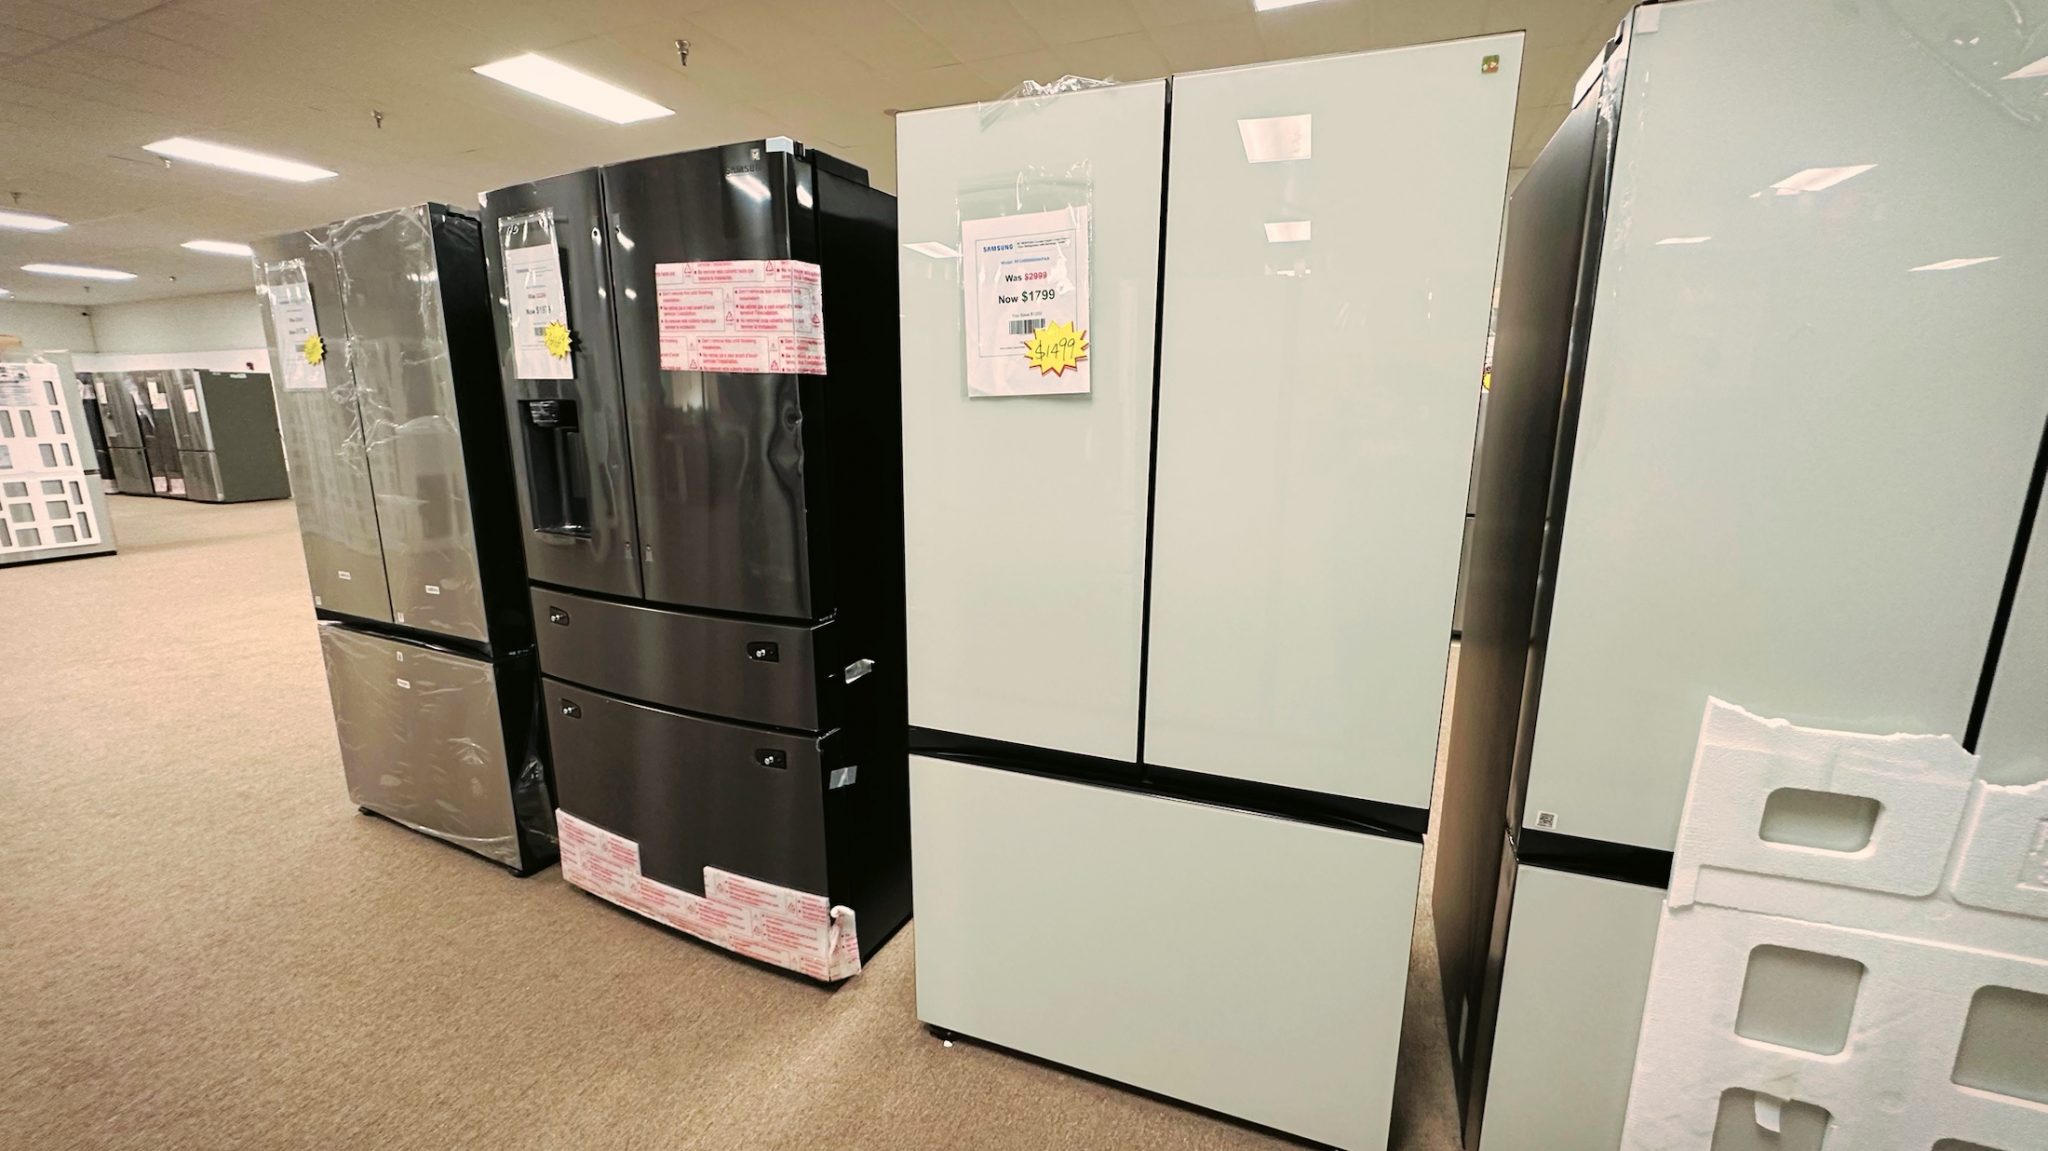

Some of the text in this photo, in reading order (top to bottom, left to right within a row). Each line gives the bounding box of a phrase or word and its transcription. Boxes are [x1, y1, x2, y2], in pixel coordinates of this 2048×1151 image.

[983, 243, 1014, 253] SAMSUNG
[1005, 274, 1022, 282] Was
[998, 289, 1056, 304] Now $1799
[1035, 337, 1075, 361] $1499
